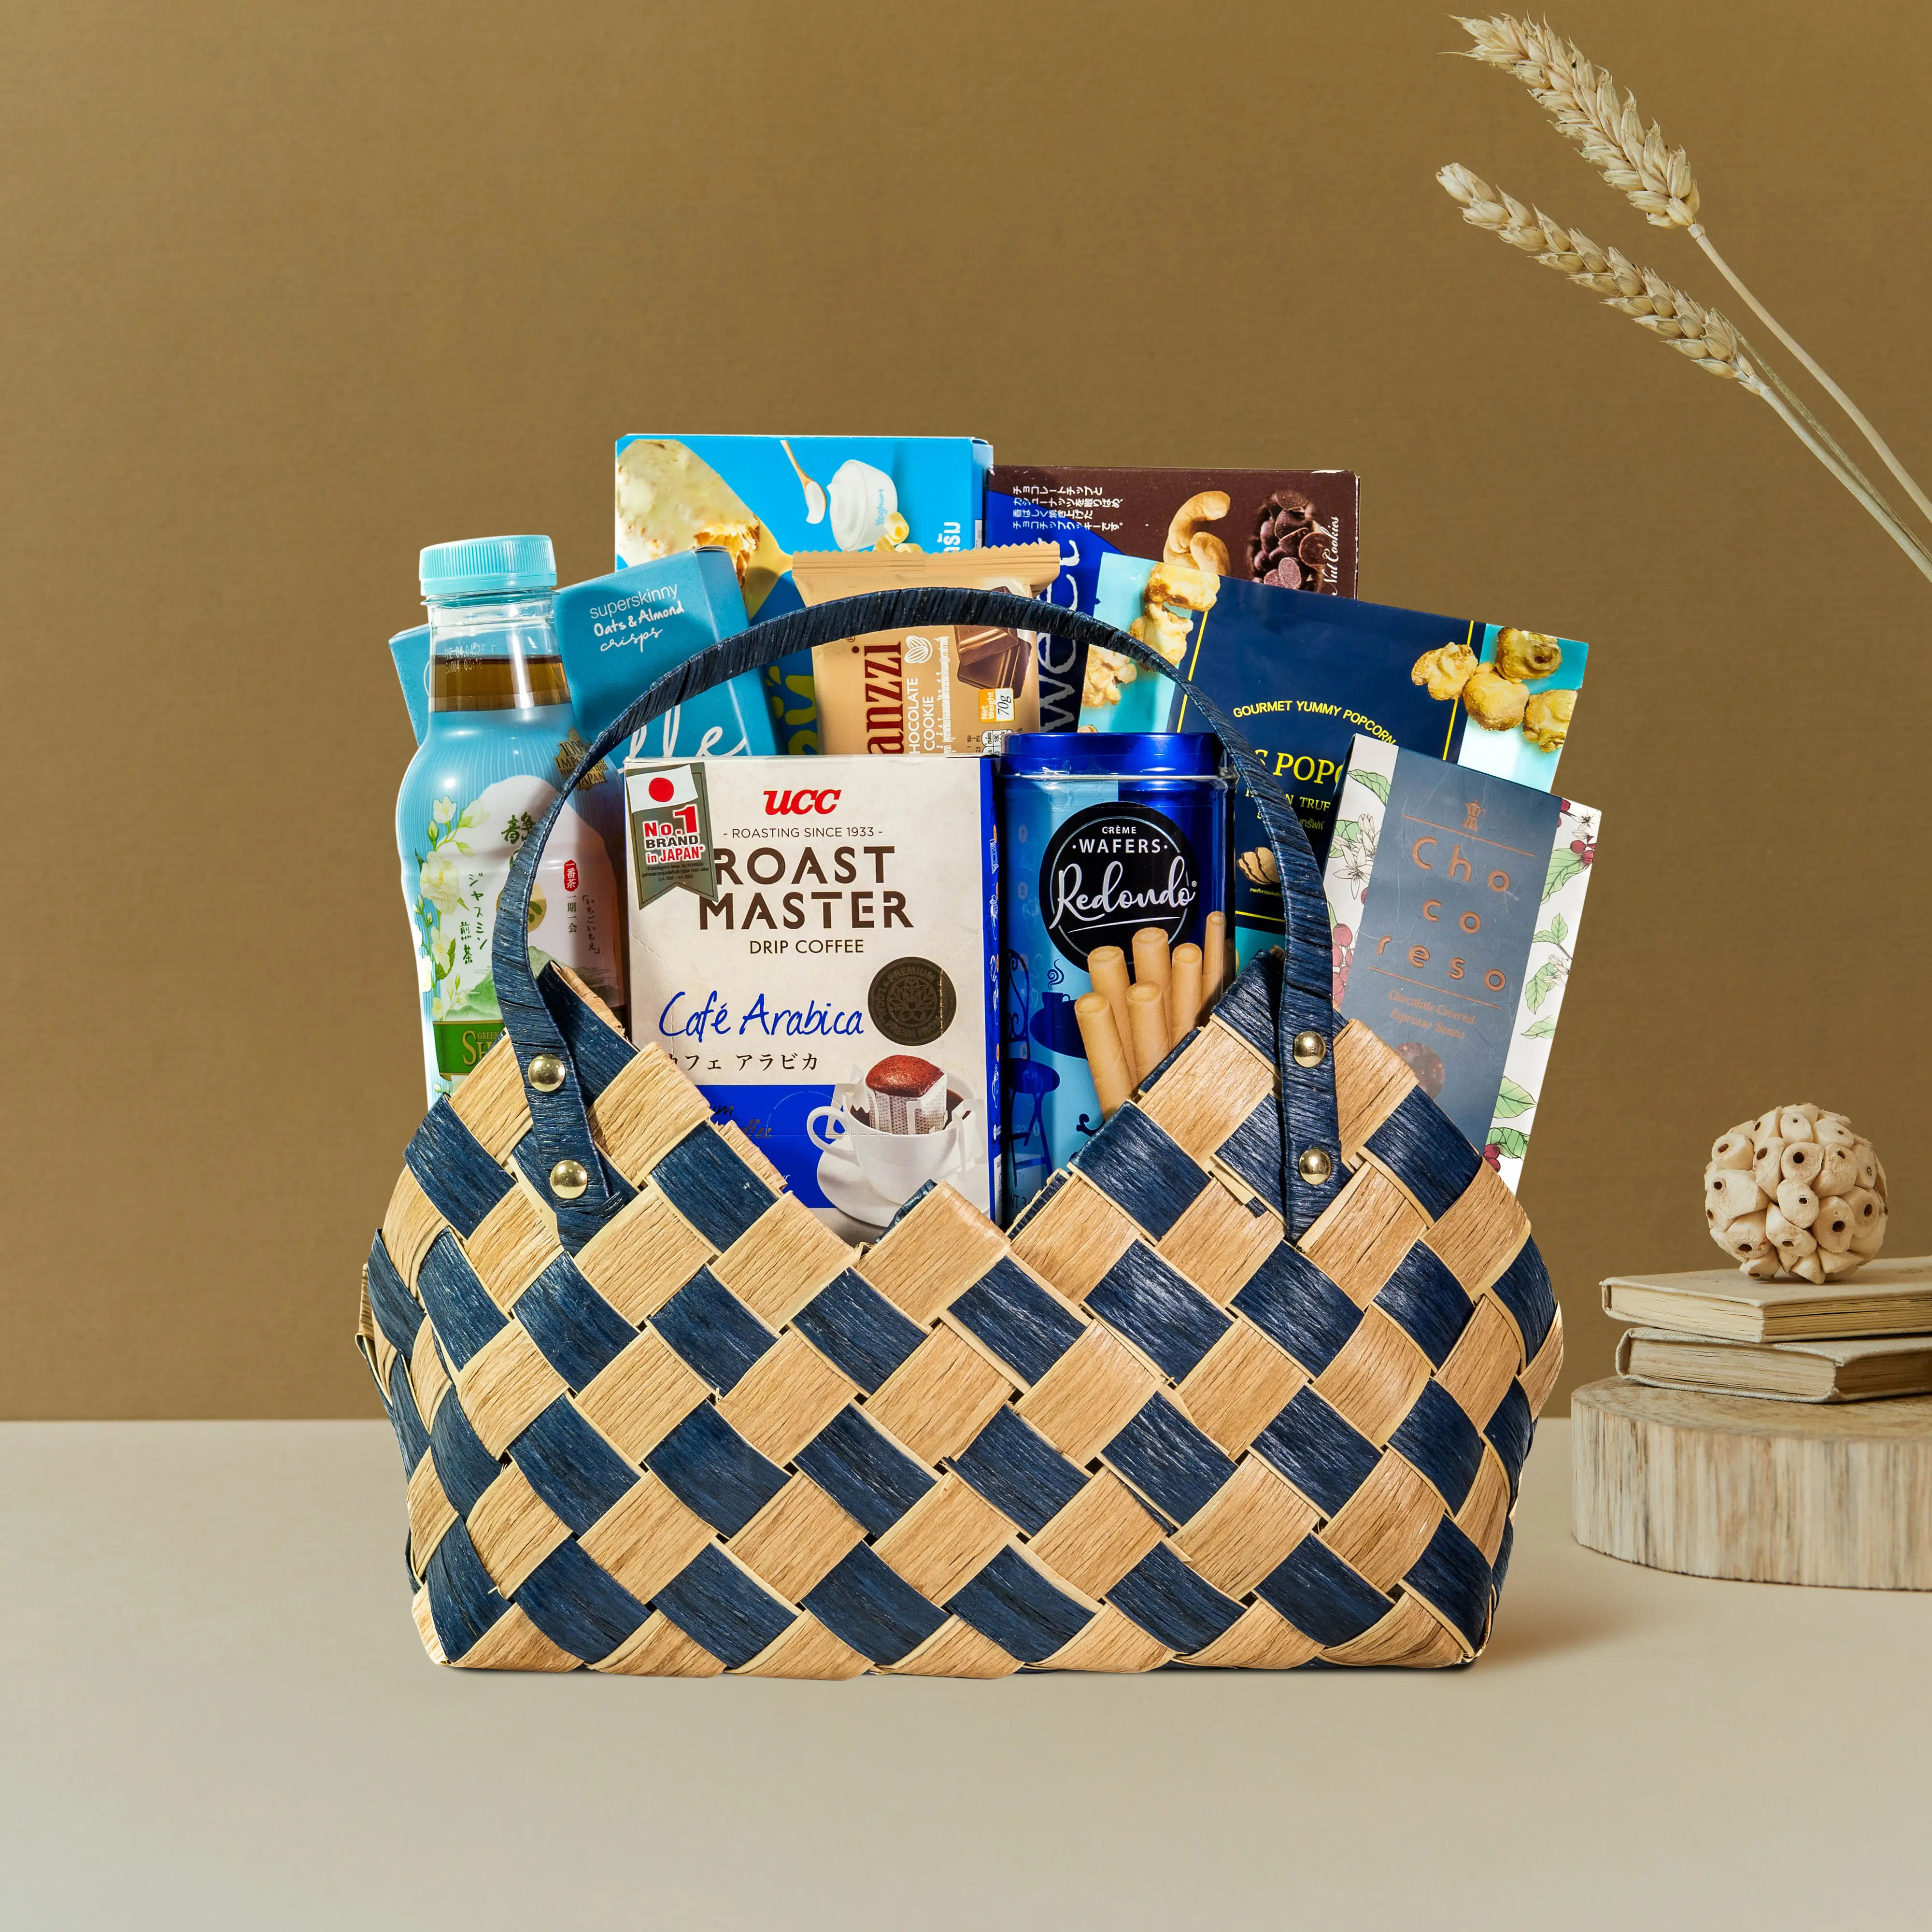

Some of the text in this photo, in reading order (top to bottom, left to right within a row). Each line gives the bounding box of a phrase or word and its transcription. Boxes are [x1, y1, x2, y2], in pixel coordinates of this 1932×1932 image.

[875, 488, 887, 526] Yoghurt
[1321, 516, 1339, 597] Nut Cookies
[590, 584, 677, 619] superskinny
[594, 600, 684, 637] Oats & Almond
[600, 627, 663, 653] crisps
[987, 691, 996, 720] Weight
[997, 694, 1011, 715] 70g
[922, 696, 936, 751] COOKIE
[1233, 700, 1397, 745] GOURMET YUMMY POPCORN
[1273, 752, 1344, 785] POP
[644, 806, 697, 838] No.1
[732, 826, 875, 839] ROASTING SINCE 1933
[1102, 825, 1136, 834] CRÈME
[645, 835, 698, 849] BRAND
[647, 853, 657, 863] in
[1079, 838, 1160, 853] WAFERS
[566, 862, 576, 889] 一番茶
[714, 846, 895, 885] ROAST
[1049, 855, 1195, 929] Redondo
[469, 872, 488, 950] ジャスミン
[567, 895, 578, 934] 一期一会
[699, 891, 914, 930] MASTER
[459, 921, 473, 965] 煎茶
[750, 938, 864, 954] DRIP COFFEE
[887, 966, 936, 982] PREMIUM
[659, 990, 865, 1043] Café Arabica
[1388, 990, 1476, 1024] Chocolate Covered
[1390, 1008, 1465, 1039] Espresso Beans
[736, 1052, 818, 1071] アラビカ
